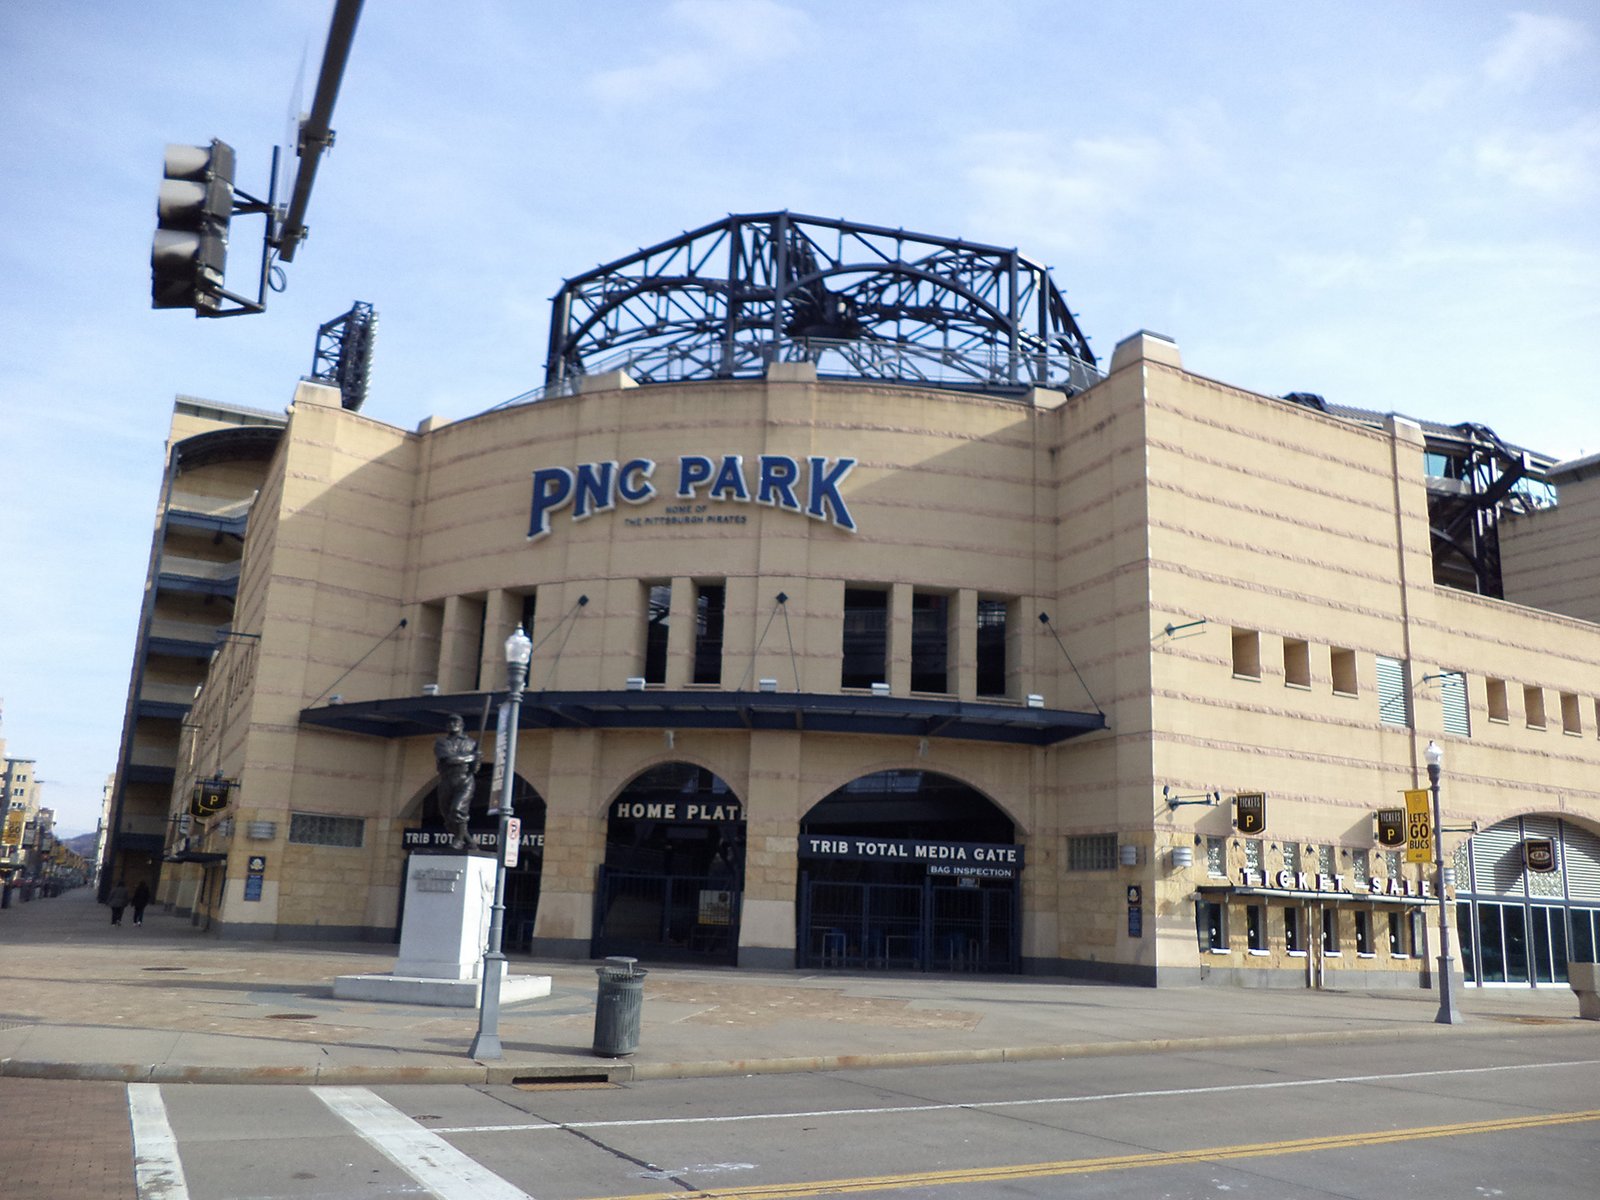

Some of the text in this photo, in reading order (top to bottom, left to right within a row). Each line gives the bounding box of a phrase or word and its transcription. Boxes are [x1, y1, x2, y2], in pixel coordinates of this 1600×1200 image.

[526, 454, 857, 542] PNC PARK
[665, 504, 708, 514] HOME OF
[645, 516, 704, 526] PITTSBURGH
[706, 514, 747, 524] PIRATES
[617, 803, 676, 819] HOME
[1246, 815, 1254, 828] P
[1409, 812, 1429, 824] LET'S
[1387, 828, 1396, 841] P
[1410, 824, 1429, 839] GO
[406, 833, 430, 844] TRIB
[433, 833, 455, 845] TOT
[519, 834, 544, 847] ATE
[1409, 839, 1430, 850] BUCS
[810, 840, 1017, 863] TRIB TOTAL MEDIA GATE
[930, 865, 1012, 877] BAG INSPECTION
[1241, 868, 1344, 891] TICKET
